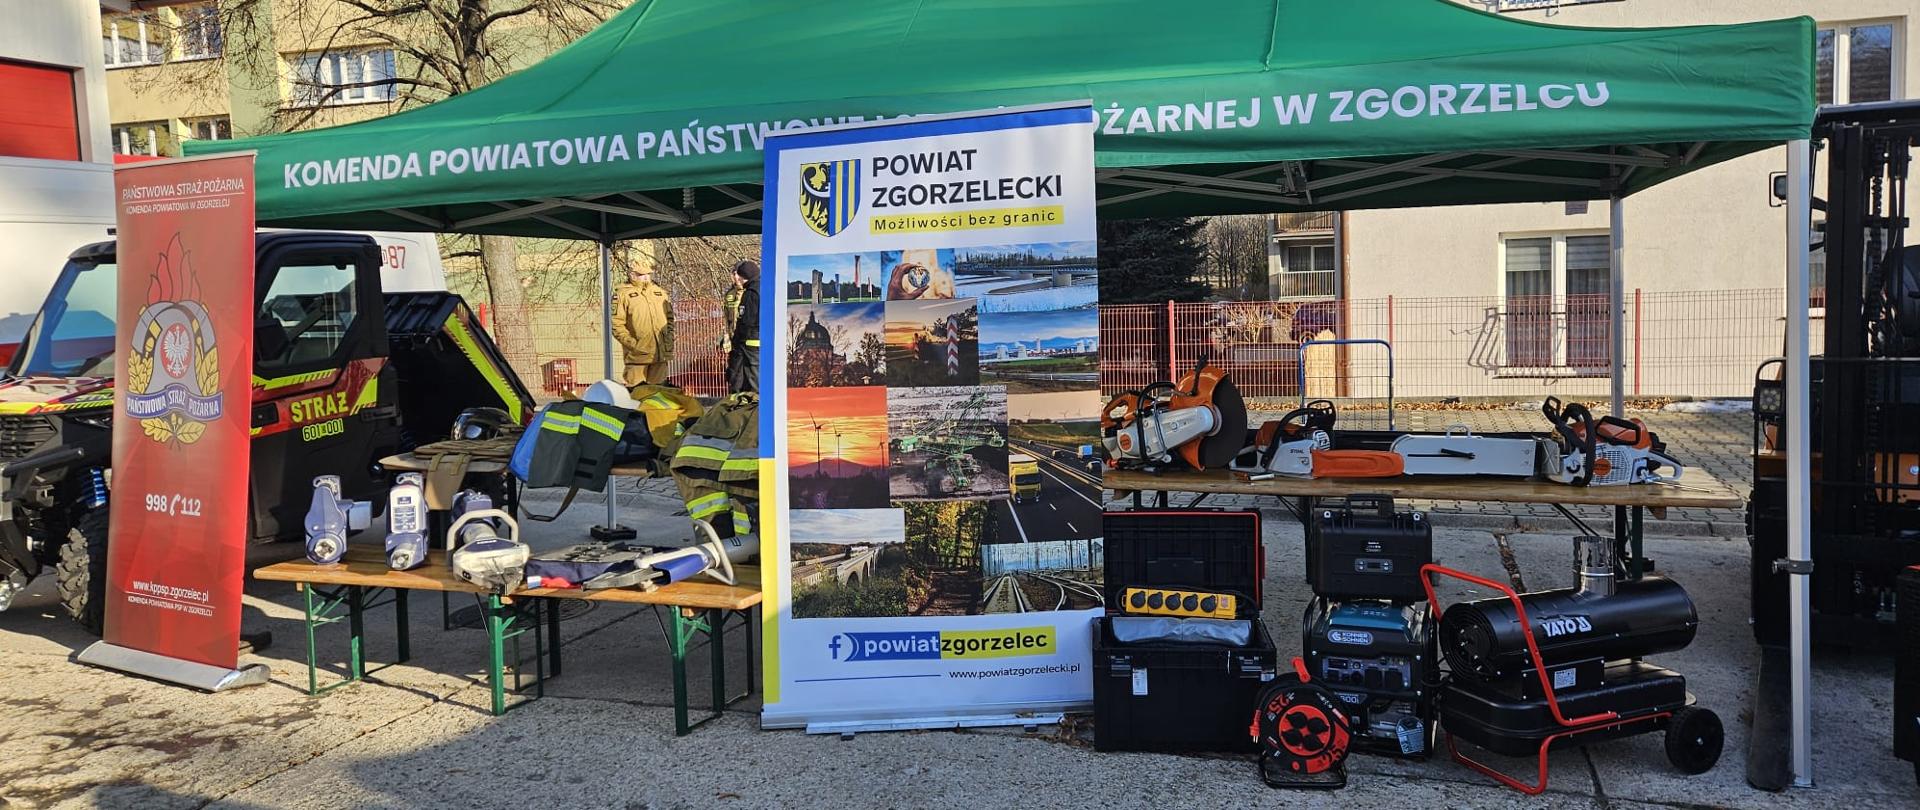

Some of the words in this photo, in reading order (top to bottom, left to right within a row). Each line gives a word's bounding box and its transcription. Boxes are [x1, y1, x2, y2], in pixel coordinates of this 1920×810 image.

[284, 152, 422, 189] KOMENDA
[429, 134, 630, 176] POWIATOWA
[637, 115, 884, 160] PAŃSTW
[1090, 97, 1261, 136] ŻARNEJ
[1272, 93, 1318, 125] W
[1329, 82, 1610, 123] ZGORZELCU
[872, 149, 978, 178] POWIAT
[122, 184, 175, 200] PAŃSTWOWA
[176, 179, 202, 196] STRAŻ
[203, 177, 244, 194] POŻARNA
[872, 175, 1062, 208] ZGORZELECKI
[126, 204, 152, 215] KOMENDA
[152, 202, 189, 213] POWIATOWA
[190, 201, 196, 209] W
[197, 198, 230, 209] ZGORZELCU
[874, 215, 963, 231] Możliwości
[969, 214, 995, 226] bez
[1003, 209, 1055, 226] granic
[127, 395, 167, 414] PAŃSTWOWA
[168, 389, 186, 405] STRAŻ
[188, 398, 220, 417] POŻARNA
[145, 493, 167, 512] 998
[180, 496, 201, 517] 112
[128, 595, 148, 605] KOMENDA
[133, 580, 209, 603] www.kppsp.zgorzelec.pl
[1542, 619, 1577, 637] YATO
[949, 663, 1081, 680] www.powiatzgorzelecki.pl
